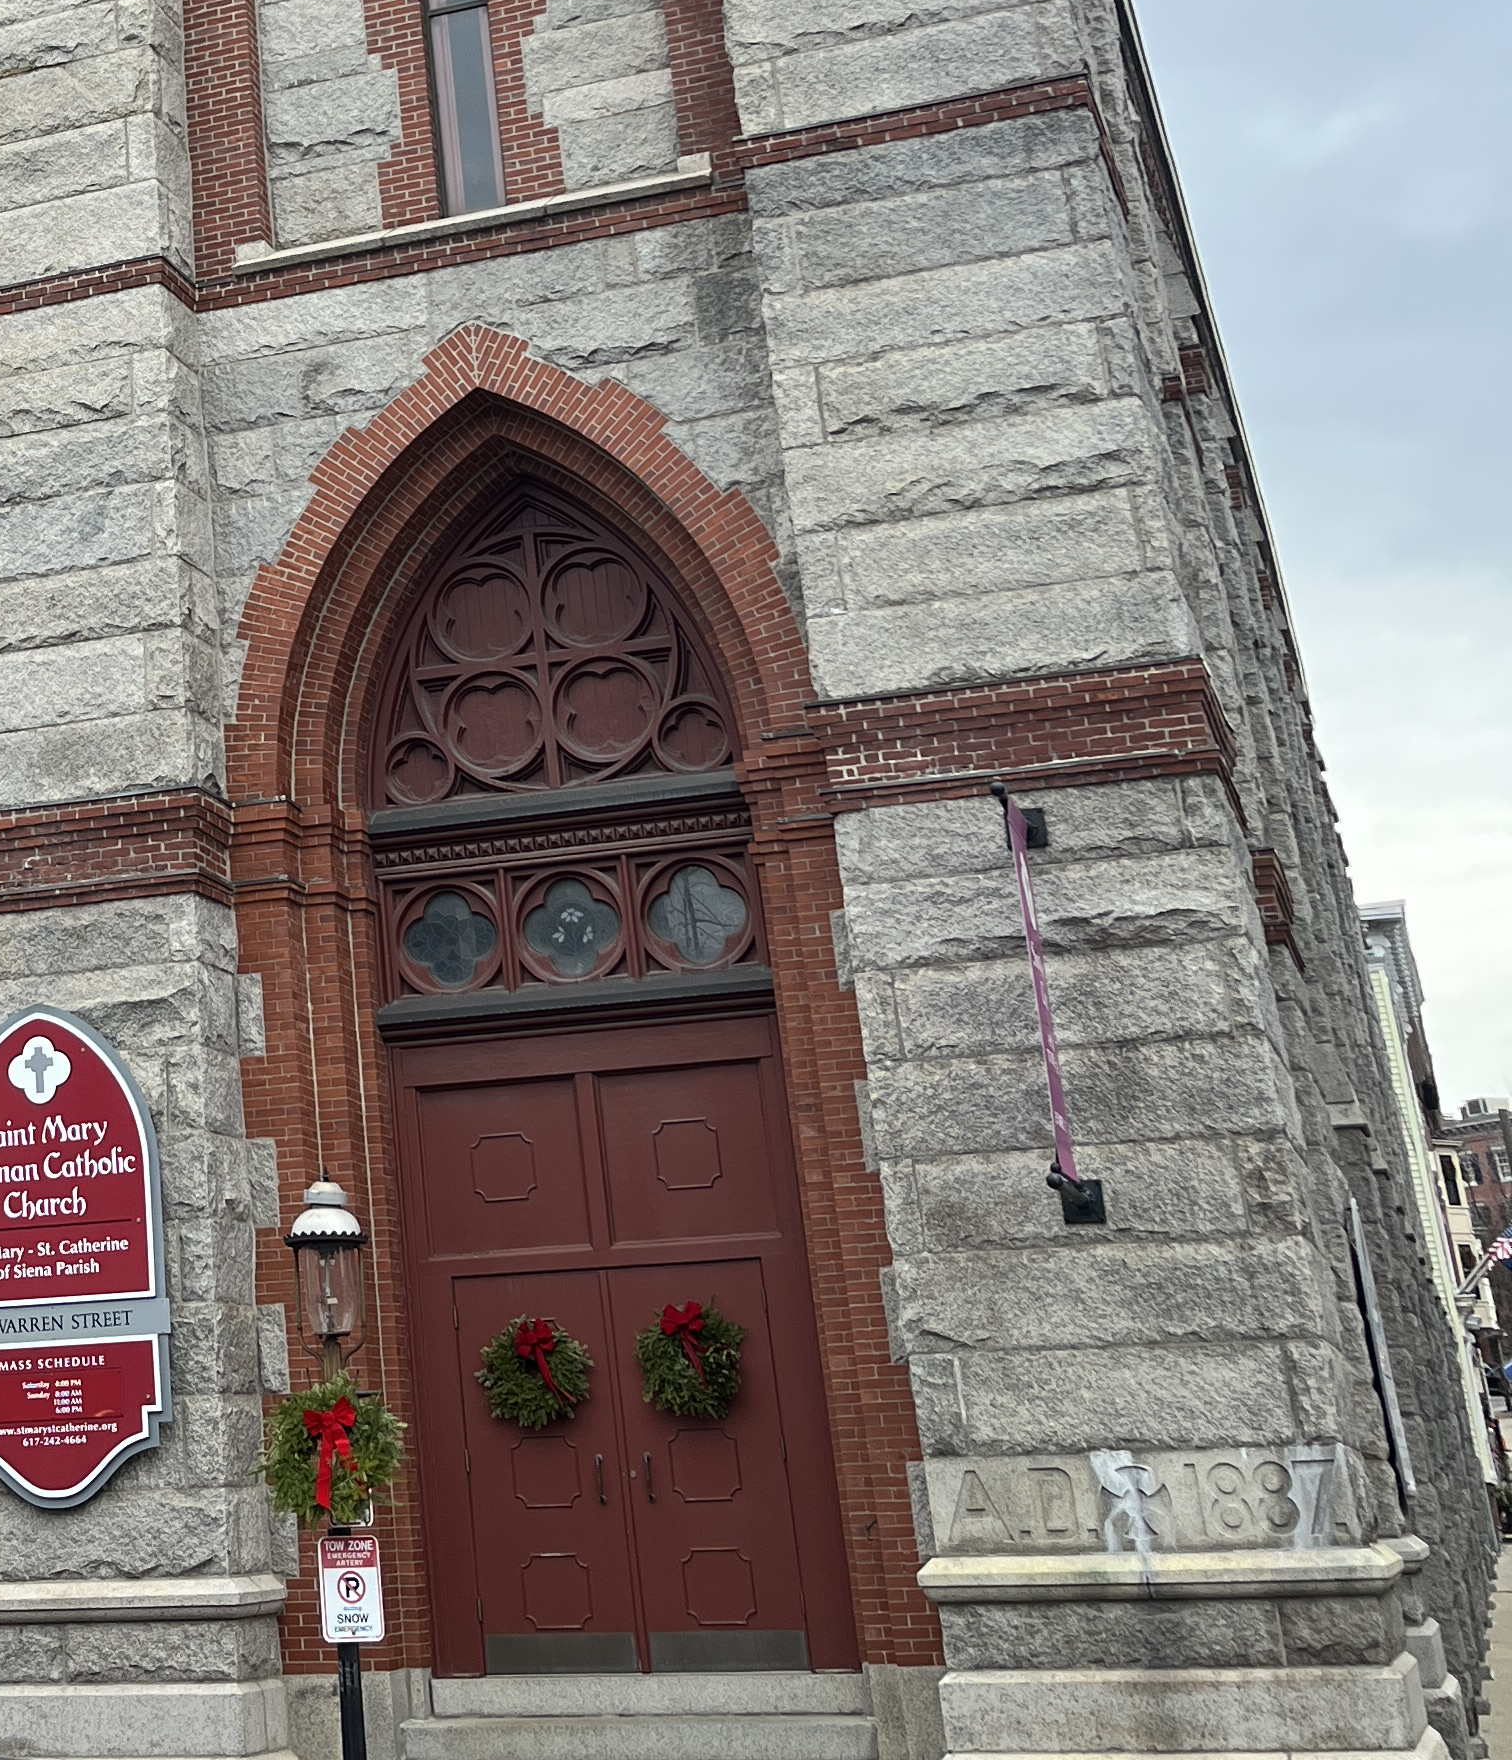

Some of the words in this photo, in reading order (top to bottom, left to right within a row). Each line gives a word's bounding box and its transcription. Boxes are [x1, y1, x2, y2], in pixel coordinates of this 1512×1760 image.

[41, 1115, 107, 1146] Mary
[43, 1146, 136, 1178] Catholic
[3, 1186, 87, 1220] Church
[37, 1242, 55, 1257] St.
[59, 1236, 129, 1255] Catherine
[13, 1263, 52, 1279] Siena
[56, 1258, 100, 1276] Parish
[71, 1310, 133, 1330] STREET
[37, 1355, 105, 1369] SCHEDULE
[26, 1391, 50, 1400] Sunday
[71, 1389, 82, 1397] AM
[22, 1435, 87, 1447] 617-242-4664
[324, 1541, 344, 1551] TOW
[348, 1540, 374, 1551] ZONE
[327, 1551, 370, 1559] EMERGENCY
[337, 1613, 369, 1624] SNOW
[334, 1625, 373, 1633] EMERGENCY
